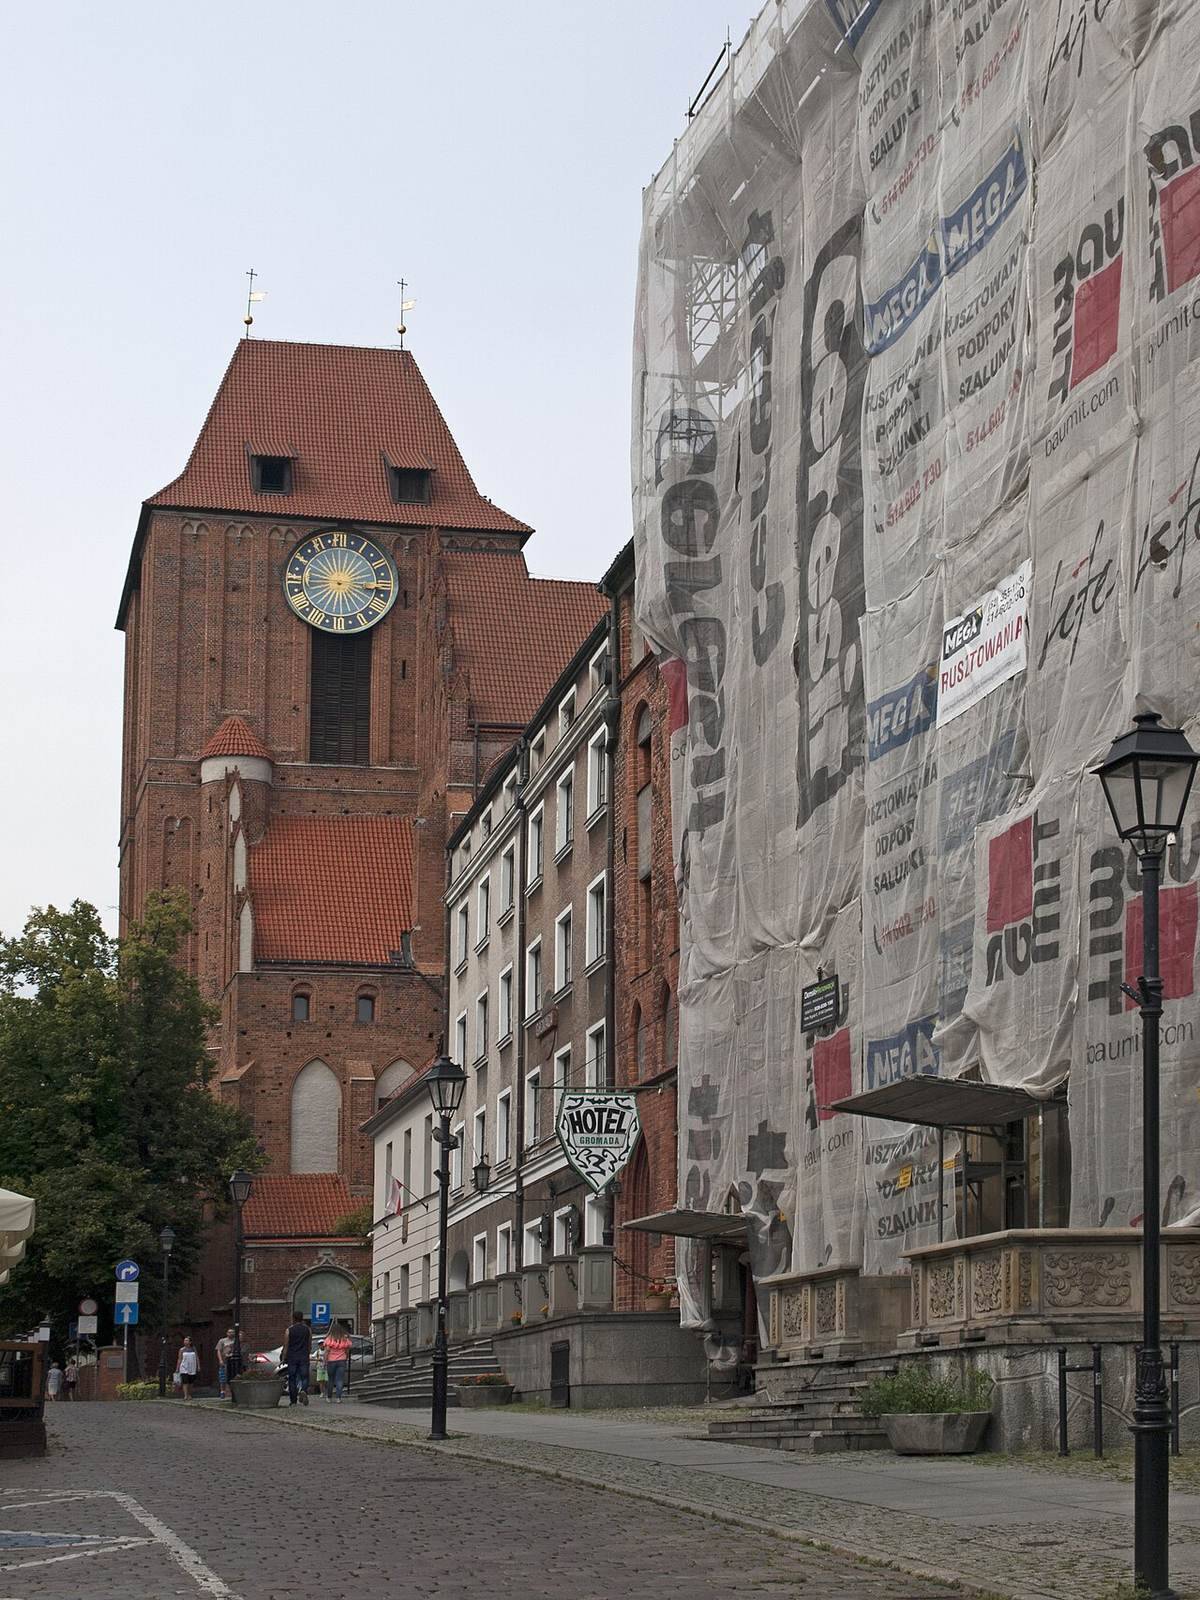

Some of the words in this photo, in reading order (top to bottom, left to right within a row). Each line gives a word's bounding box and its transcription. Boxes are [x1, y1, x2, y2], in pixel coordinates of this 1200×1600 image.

[948, 162, 1016, 265] MEGA
[871, 262, 930, 346] MEGA
[957, 287, 1016, 366] PODPORY
[1044, 377, 1119, 457] baumit.com
[941, 615, 1024, 695] RUSZTOWANIA
[945, 615, 978, 656] MEGA
[569, 1107, 627, 1134] HOTEL
[579, 1136, 620, 1145] GROMADA
[878, 1199, 938, 1237] SZALUNK
[315, 1304, 327, 1318] P
